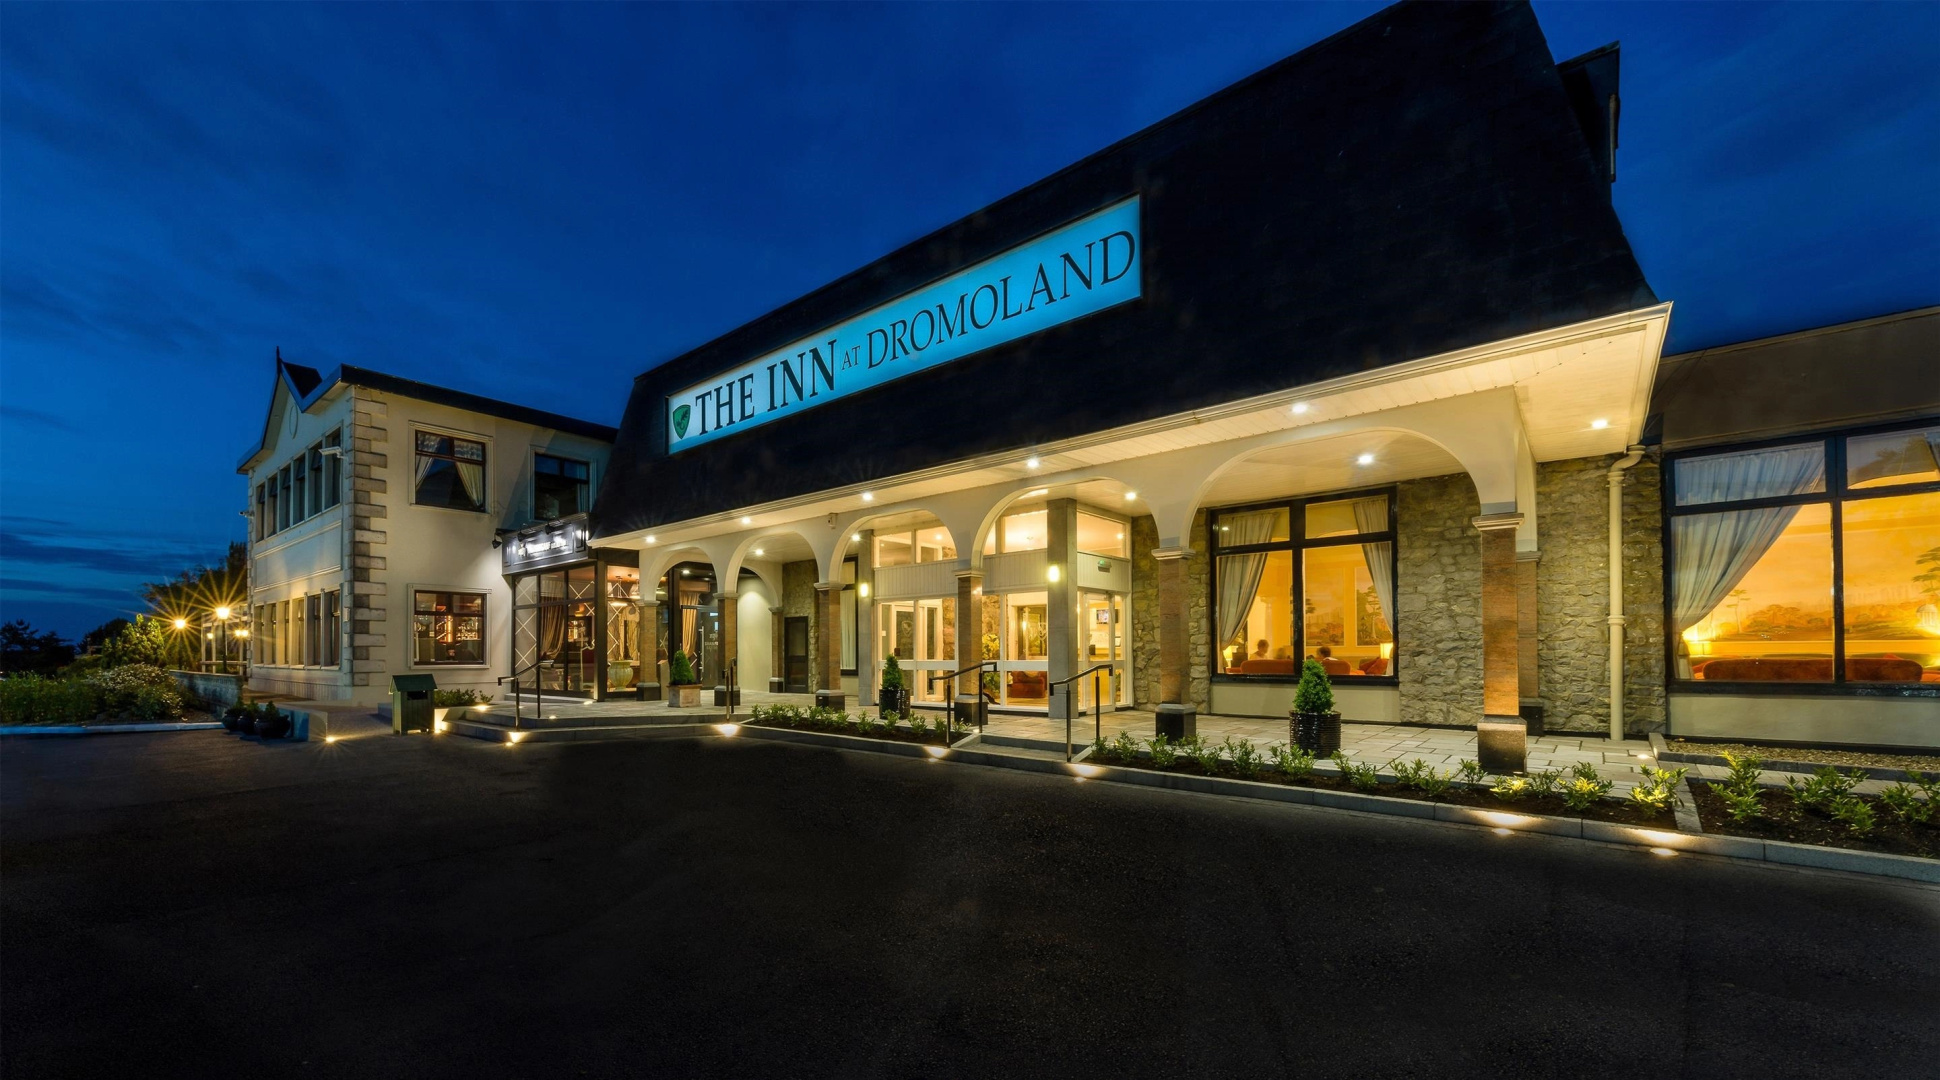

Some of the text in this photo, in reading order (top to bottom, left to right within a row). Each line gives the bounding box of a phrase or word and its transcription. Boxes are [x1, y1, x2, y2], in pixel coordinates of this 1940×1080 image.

[695, 230, 1136, 436] THE INN AT DROMOLAND
